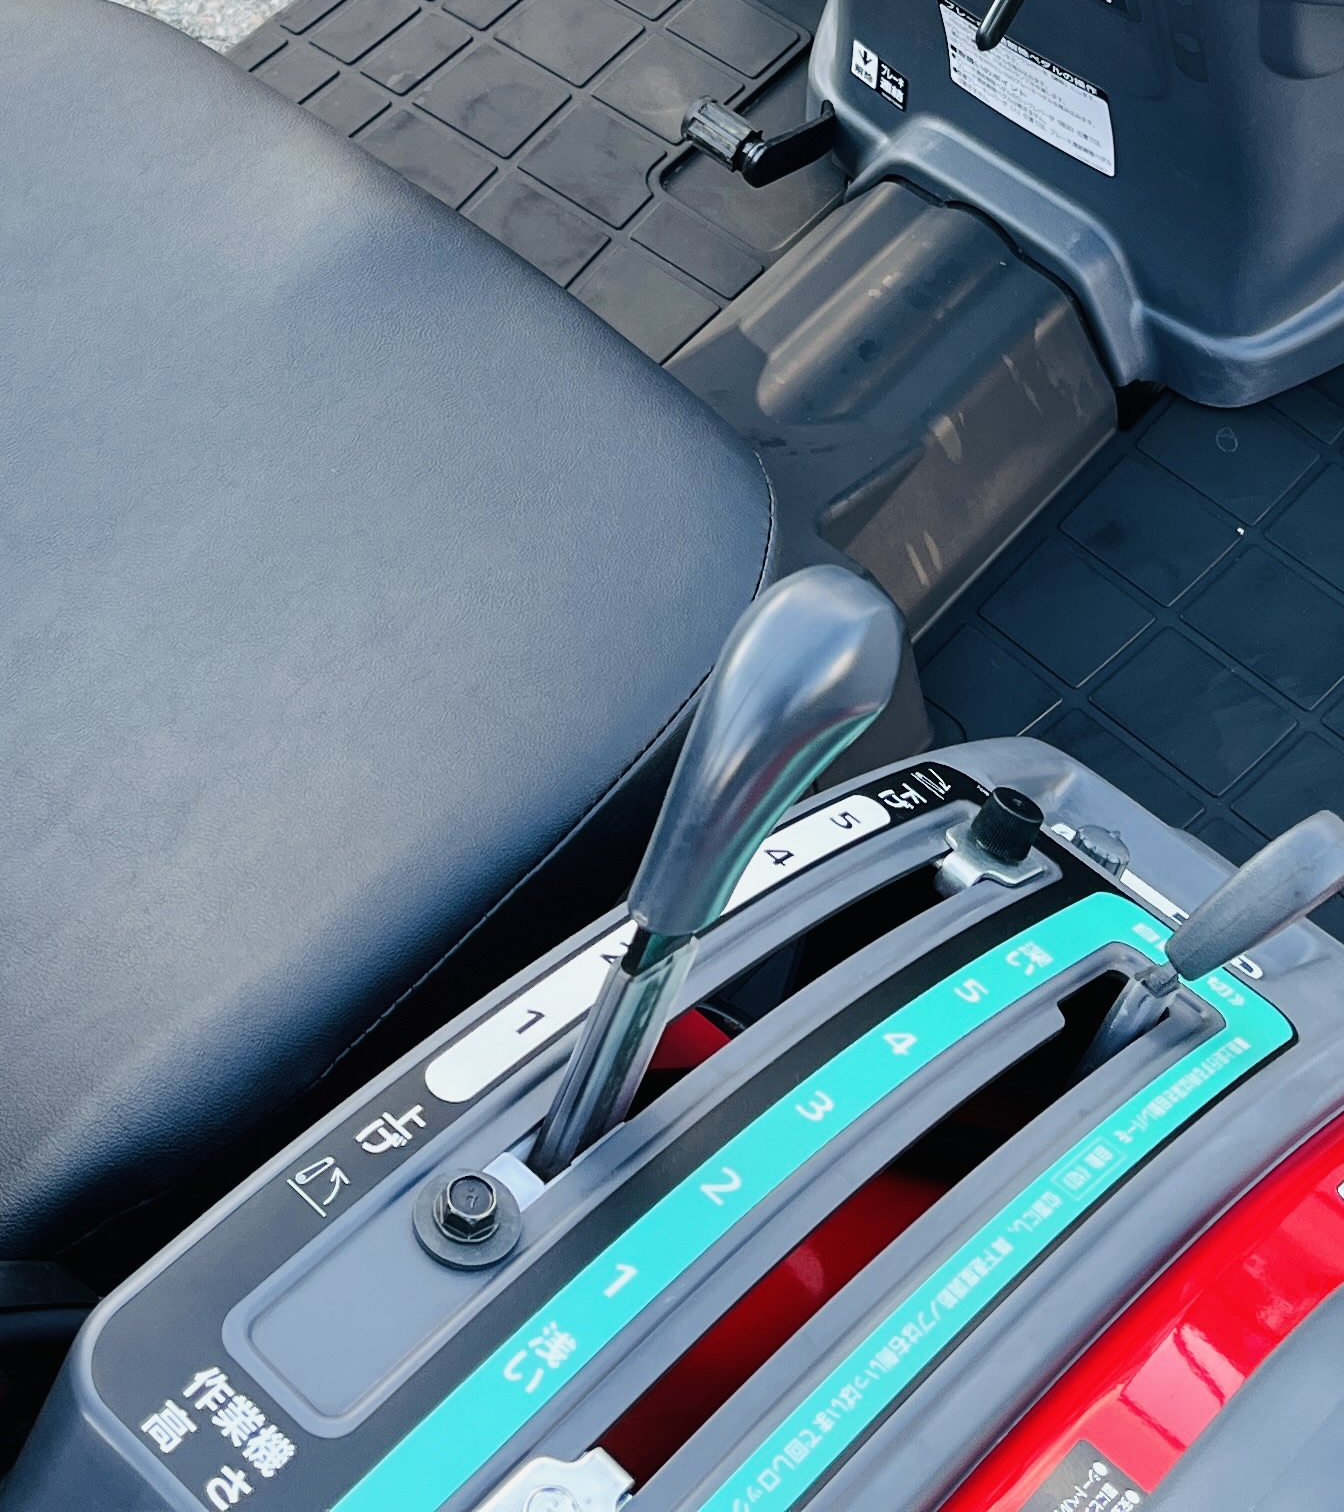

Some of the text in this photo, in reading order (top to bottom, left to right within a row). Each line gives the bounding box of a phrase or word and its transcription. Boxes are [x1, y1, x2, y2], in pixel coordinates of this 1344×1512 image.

[829, 811, 861, 831] 5
[763, 847, 795, 868] 4
[954, 978, 990, 1004] 5
[514, 1008, 546, 1036] 1
[882, 1031, 918, 1056] 4
[794, 1090, 836, 1123] 3
[356, 1104, 426, 1154] 上げ
[700, 1167, 742, 1207] 2
[601, 1263, 639, 1299] 1
[502, 1321, 577, 1395] 浅い
[182, 1366, 297, 1479] 作業機
